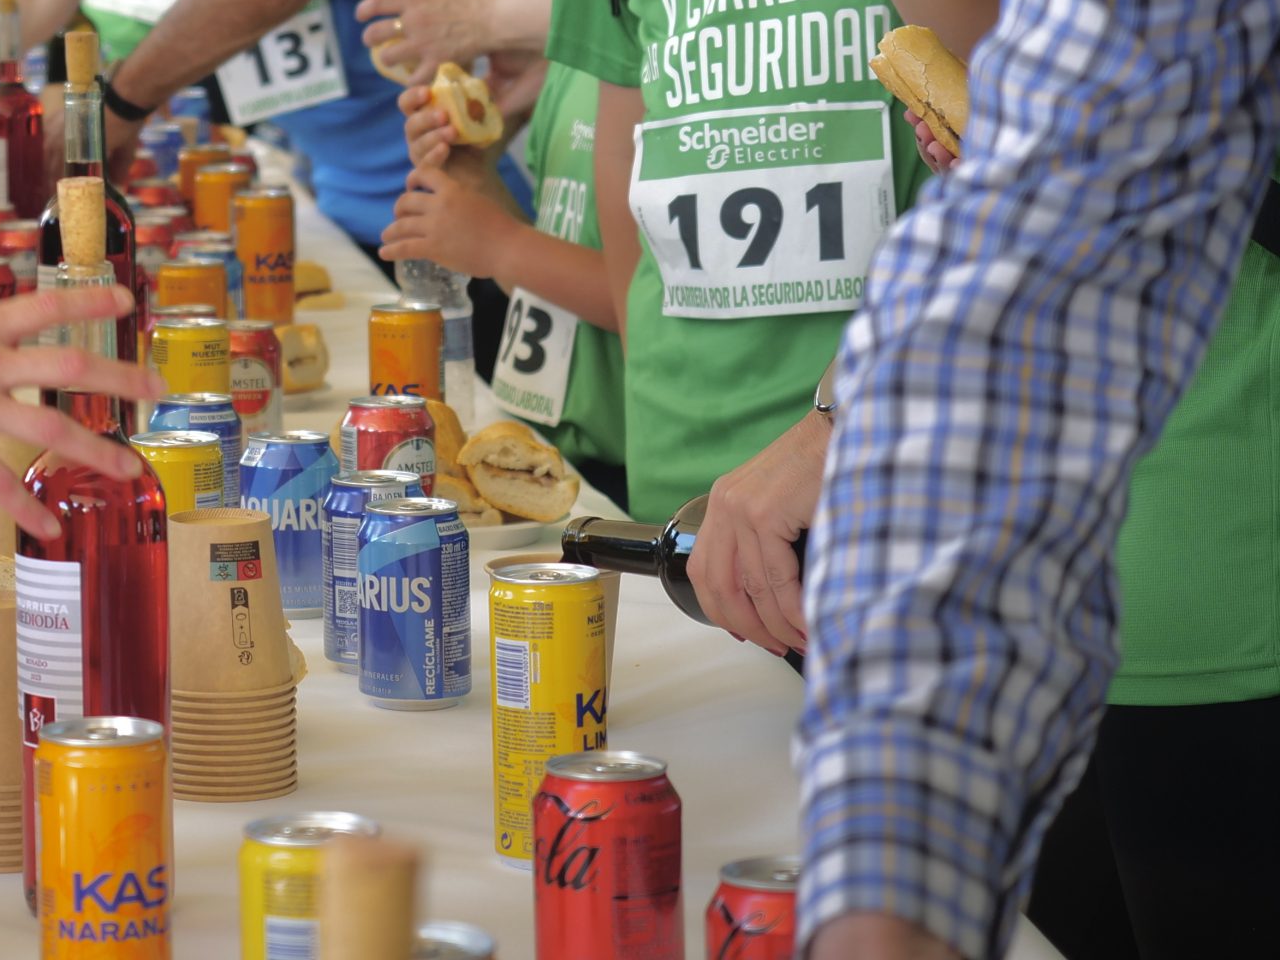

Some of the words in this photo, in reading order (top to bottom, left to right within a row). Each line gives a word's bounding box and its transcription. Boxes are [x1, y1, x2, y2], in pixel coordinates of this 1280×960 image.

[663, 5, 891, 108] SEGURIDAD
[678, 115, 825, 153] Schneider
[734, 144, 824, 164] Electric
[668, 181, 845, 271] 191
[674, 284, 710, 309] CARRERA
[710, 286, 730, 309] POR
[733, 286, 750, 308] LA
[752, 279, 824, 307] SEGURIDAD
[231, 378, 267, 389] MSTEL
[515, 389, 555, 419] LABORAL
[396, 461, 434, 474] AMSTEL
[372, 493, 393, 502] BAJO
[21, 600, 69, 615] RRIETA
[356, 572, 431, 613] ARIUS
[423, 618, 435, 696] RECÍCLAME
[73, 864, 168, 914] KAS
